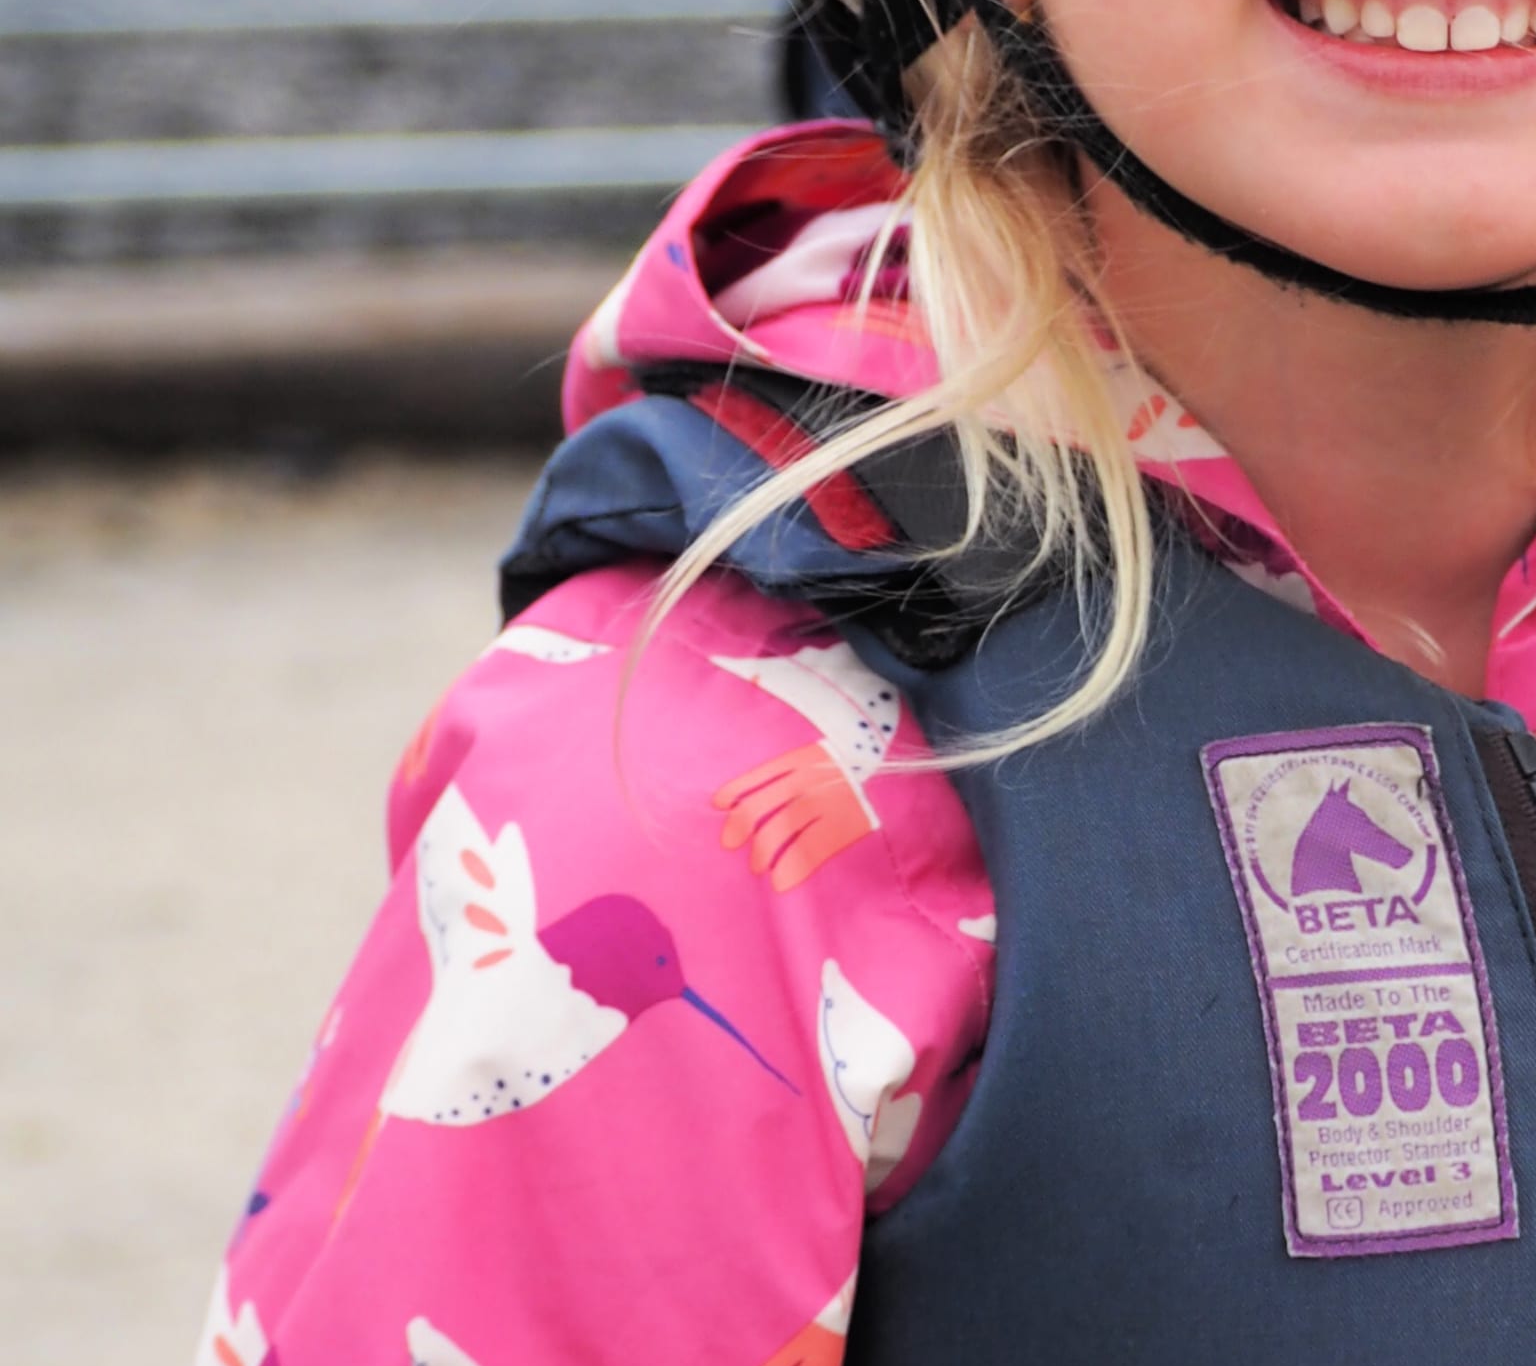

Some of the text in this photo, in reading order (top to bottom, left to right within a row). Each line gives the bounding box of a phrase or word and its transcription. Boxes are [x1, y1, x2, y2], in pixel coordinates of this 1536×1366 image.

[1294, 895, 1420, 934] BETA
[1285, 935, 1442, 964] Certification Mark
[1302, 985, 1451, 1013] Made To The
[1296, 1010, 1465, 1048] BETA
[1293, 1038, 1480, 1122] 2000
[1318, 1116, 1472, 1146] Body & Shoulder
[1308, 1136, 1480, 1167] Protector Standard
[1321, 1162, 1472, 1192] Level 3
[1379, 1190, 1473, 1218] Approved
